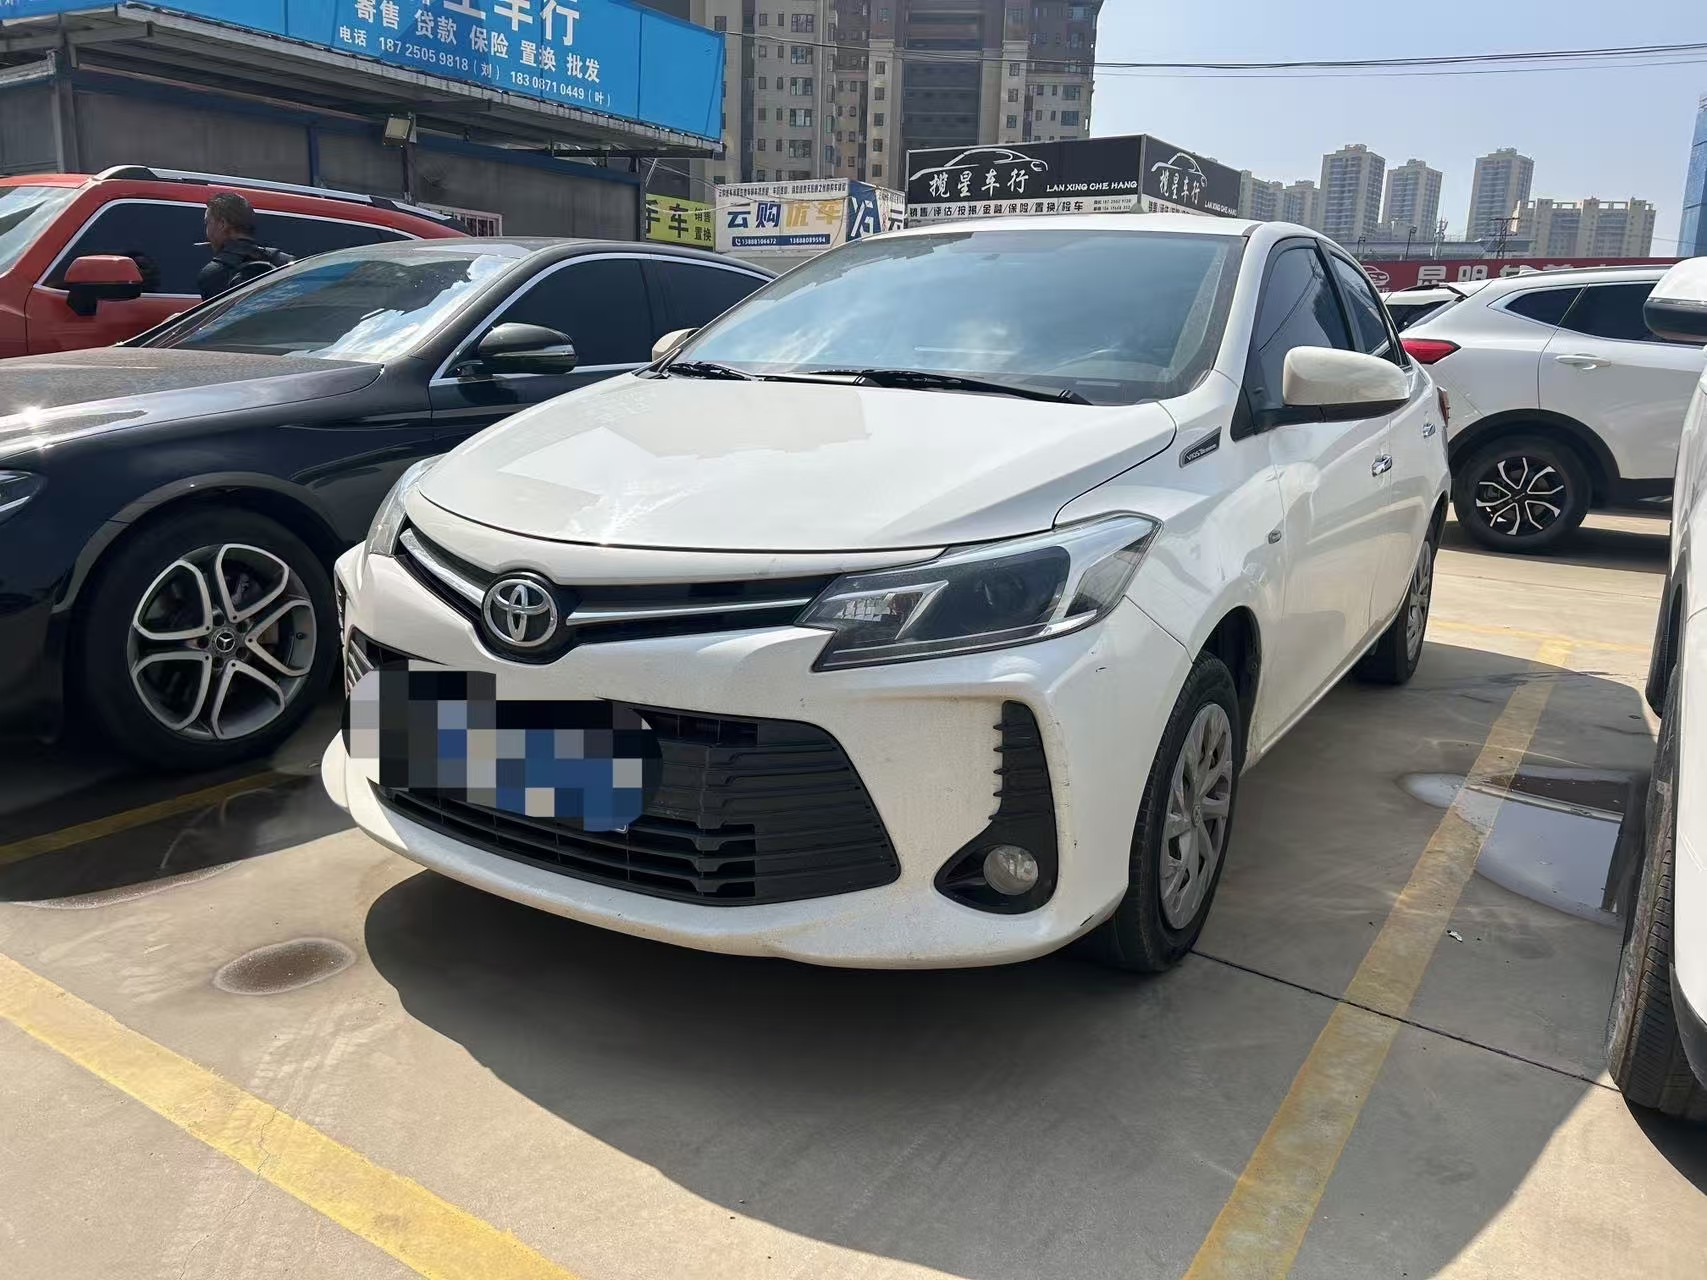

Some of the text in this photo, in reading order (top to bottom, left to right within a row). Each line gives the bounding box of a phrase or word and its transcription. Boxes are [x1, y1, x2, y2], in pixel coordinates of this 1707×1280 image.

[340, 25, 367, 47] 电话
[379, 37, 401, 53] 187
[405, 43, 436, 63] 2505
[511, 71, 530, 86] 183
[355, 0, 600, 83] 寄售 贷款 保险 置换 批发
[929, 168, 1029, 198] 揽星车行
[1046, 184, 1065, 192] LAN
